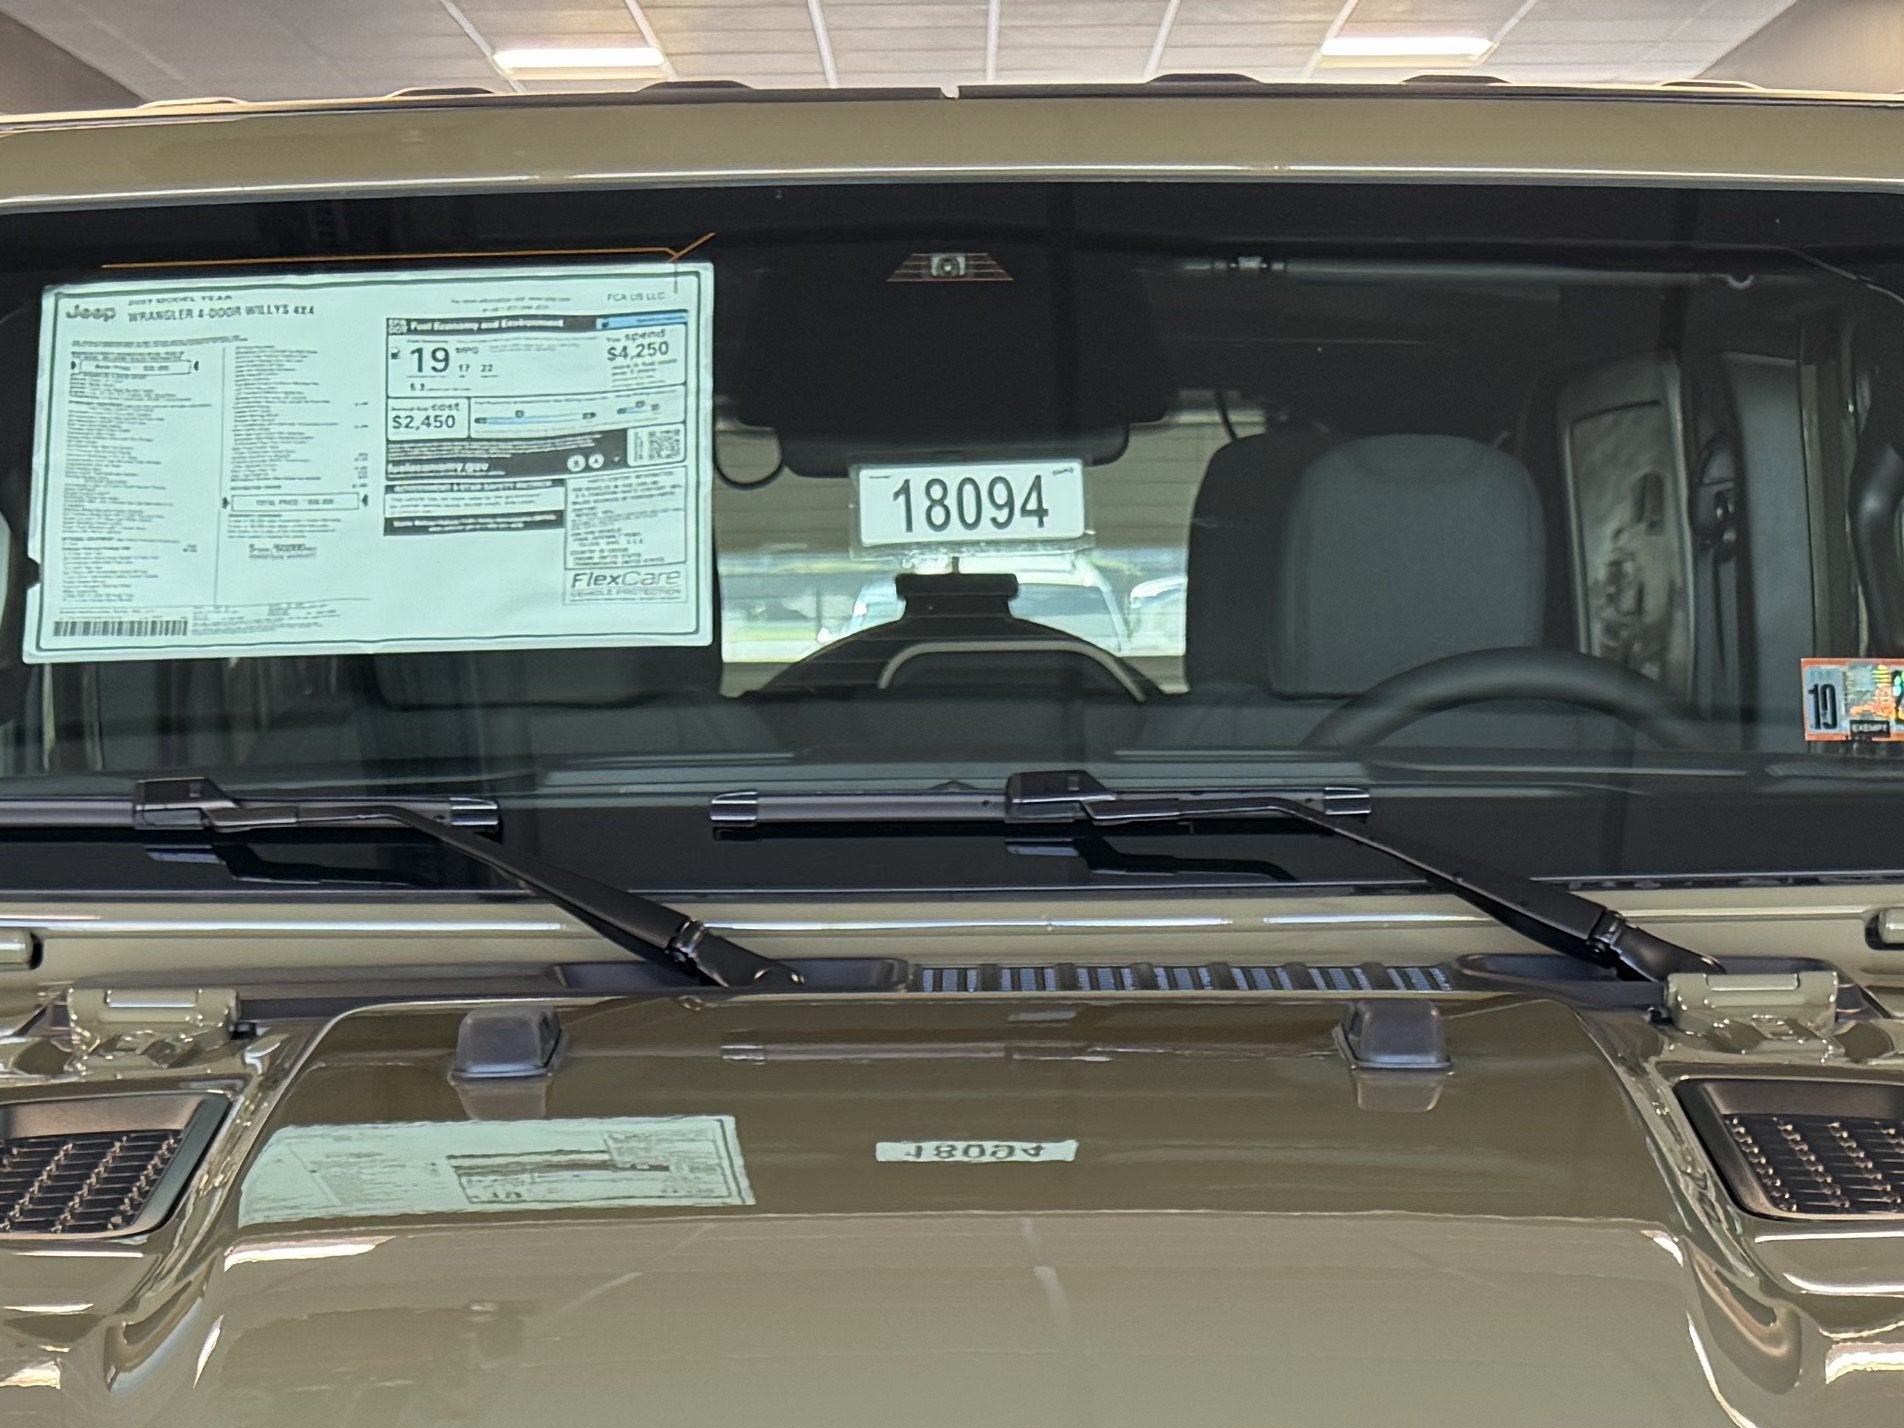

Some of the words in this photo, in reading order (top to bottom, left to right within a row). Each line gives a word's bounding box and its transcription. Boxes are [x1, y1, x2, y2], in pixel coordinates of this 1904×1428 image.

[65, 304, 117, 322] Jeep
[128, 308, 193, 322] WRANGLER
[246, 304, 289, 316] WILLYS
[624, 329, 666, 343] spend
[409, 346, 450, 373] 19
[606, 341, 669, 361] $4,250
[392, 414, 456, 431] $2,450
[892, 473, 1049, 534] 18094
[571, 570, 681, 589] FlexCare
